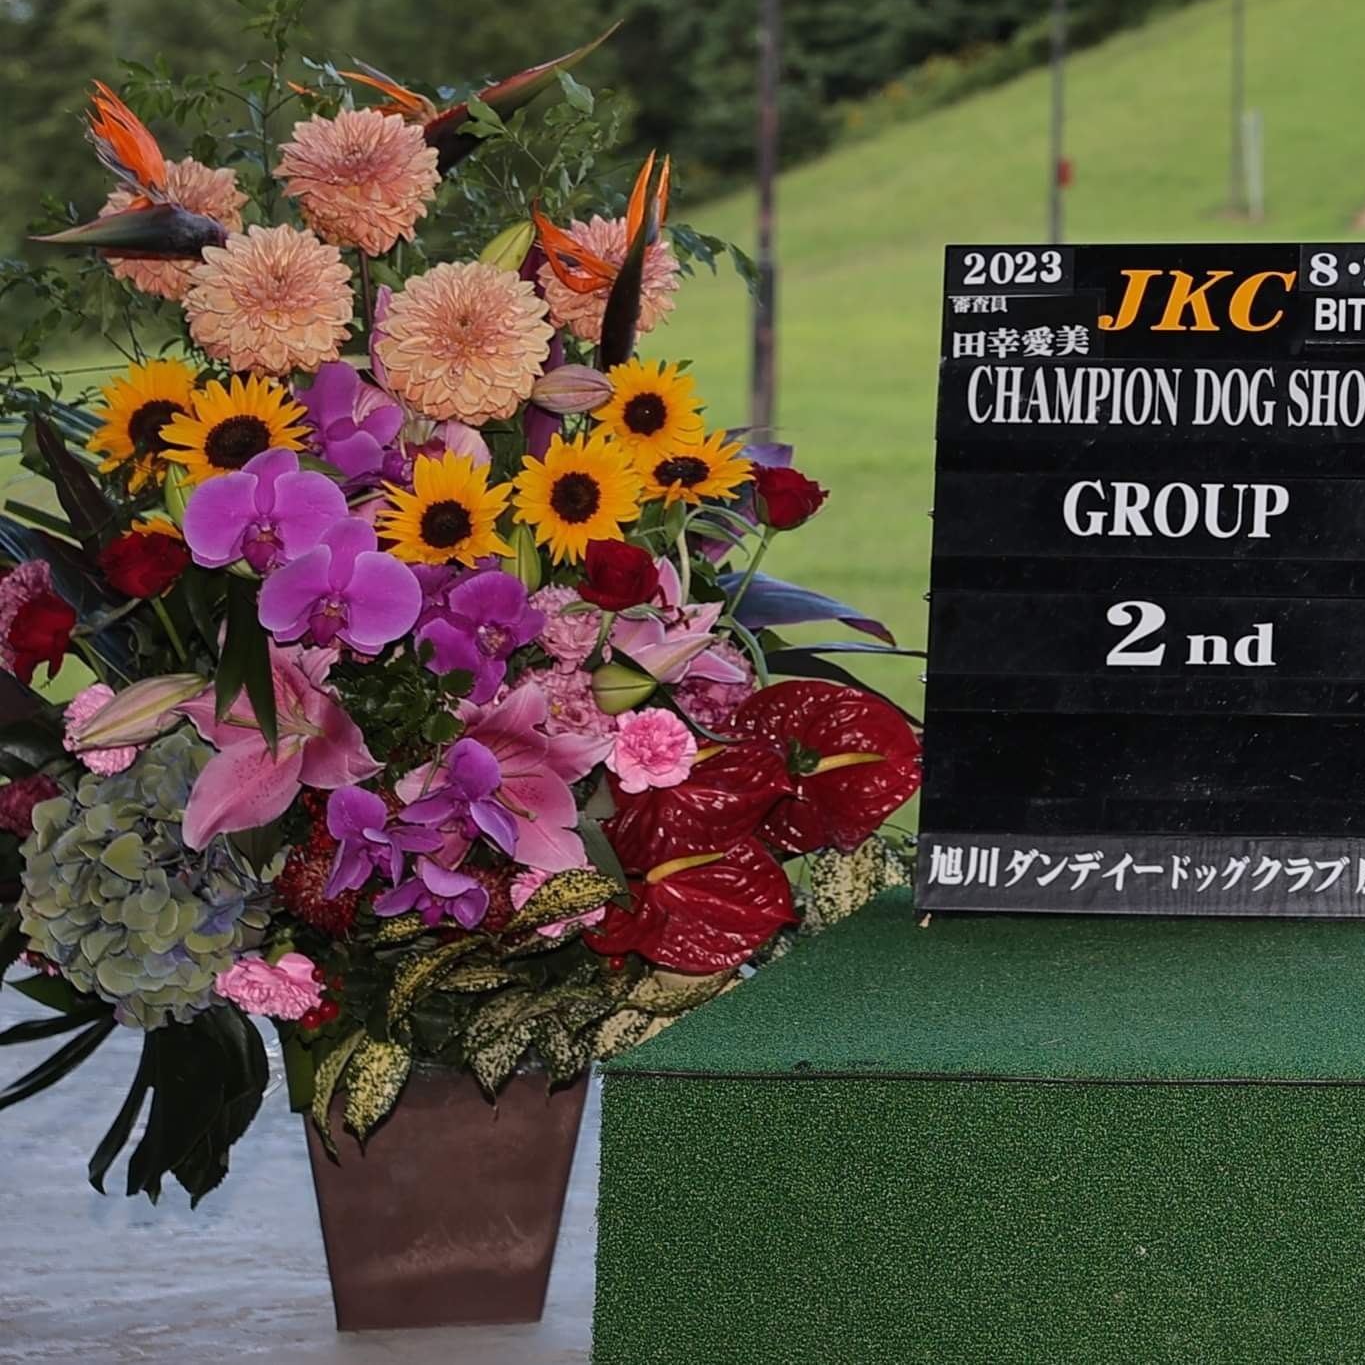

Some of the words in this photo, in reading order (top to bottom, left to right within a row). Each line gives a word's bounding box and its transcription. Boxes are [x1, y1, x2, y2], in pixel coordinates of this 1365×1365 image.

[963, 250, 1062, 285] 2023
[1097, 269, 1297, 332] JKC
[953, 324, 1089, 359] 田幸愛美
[967, 365, 1183, 426] CHAMPION
[1191, 367, 1277, 427] DOG
[1063, 479, 1290, 539] GROUP
[1106, 600, 1166, 666] 2
[1185, 622, 1276, 667] nd
